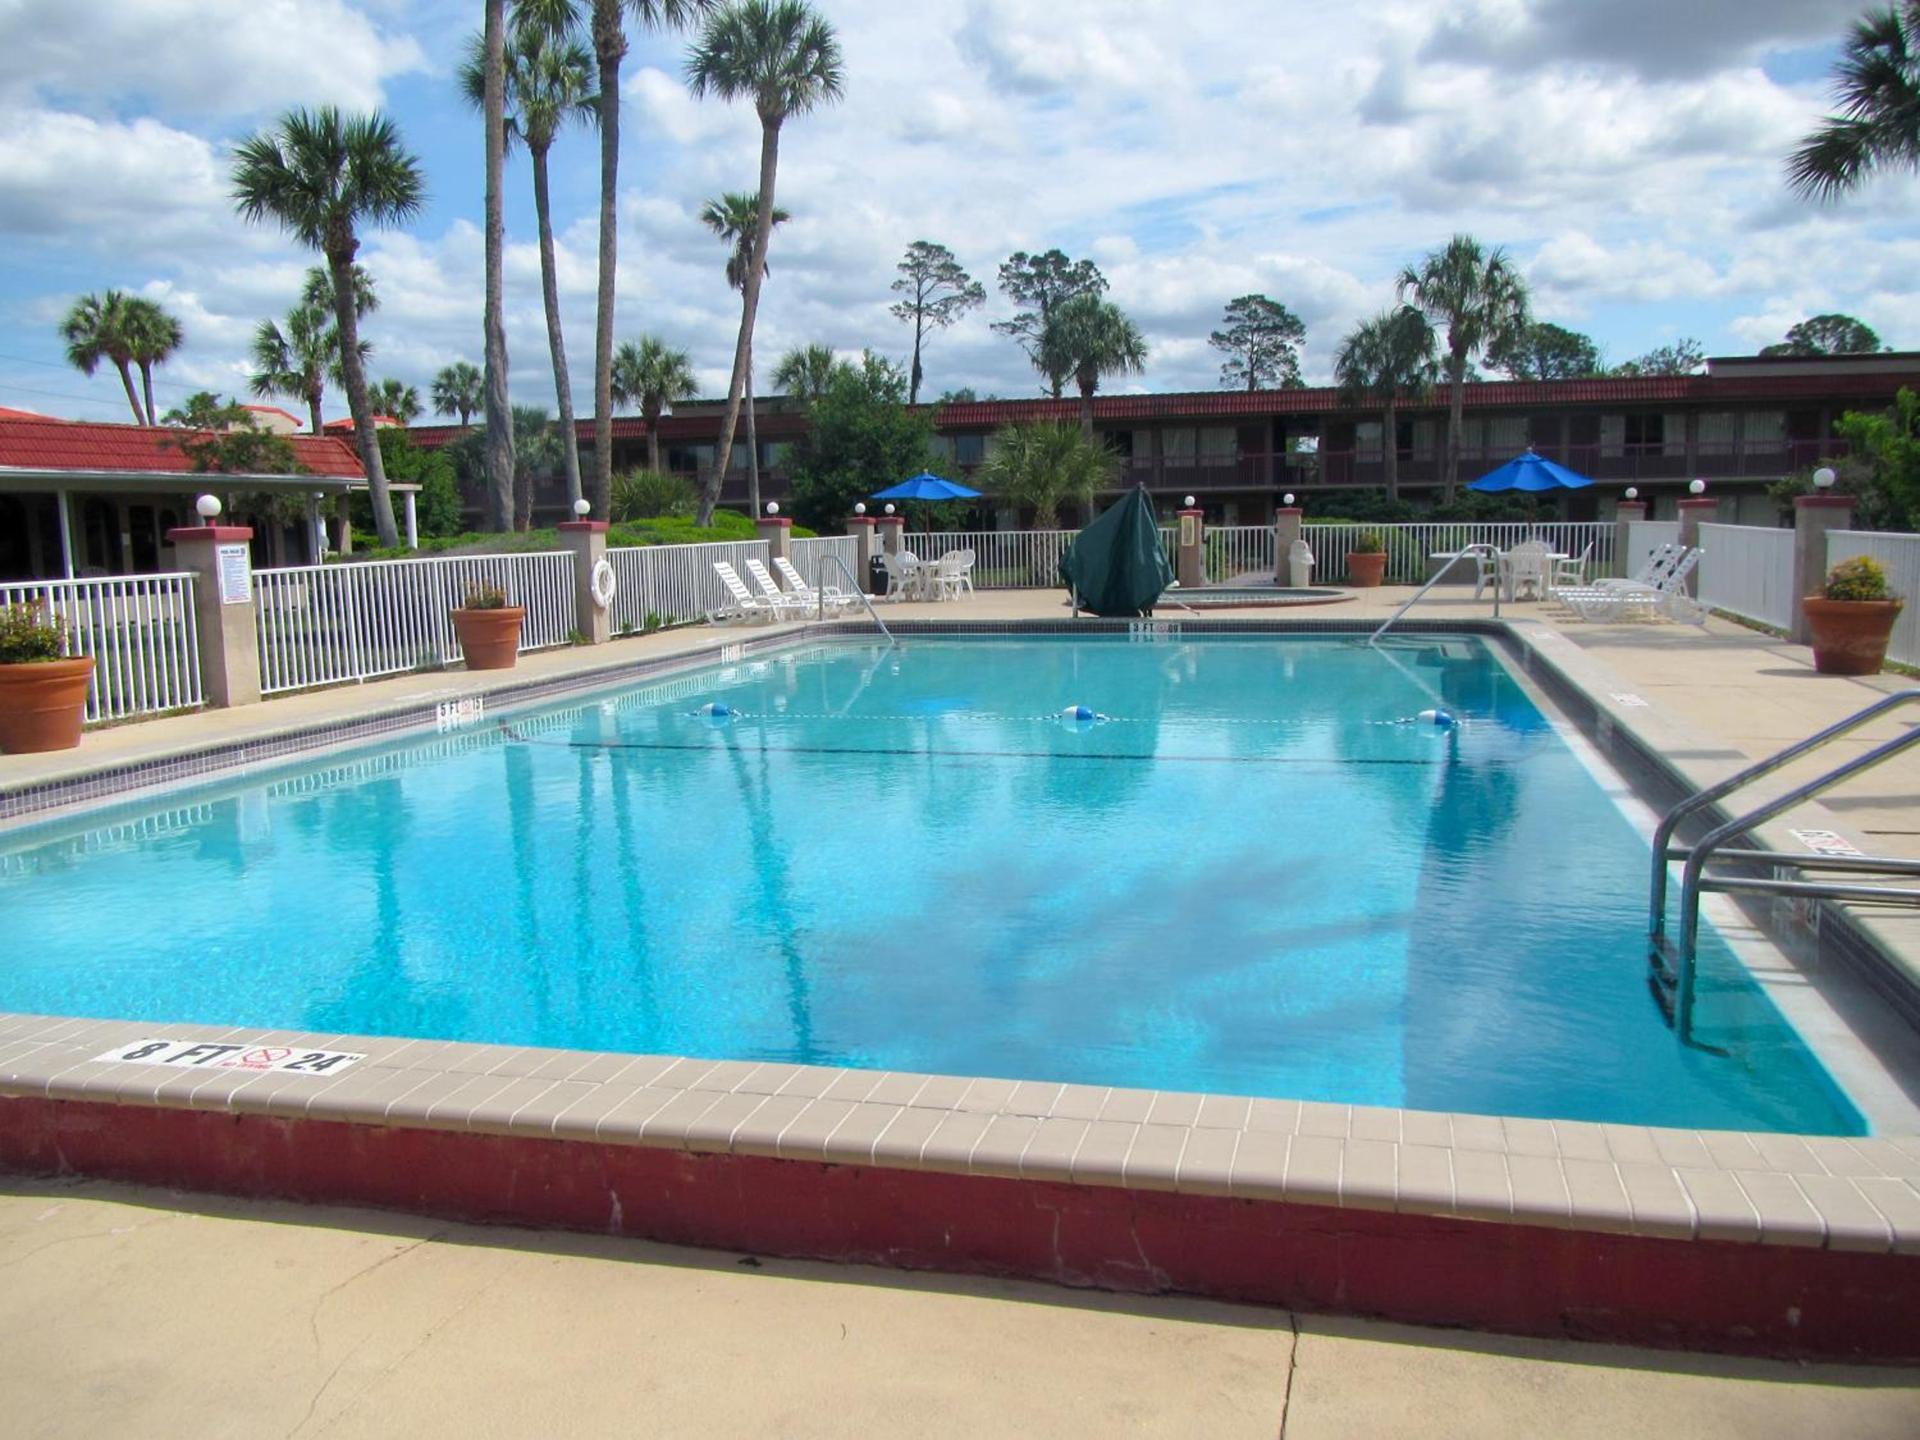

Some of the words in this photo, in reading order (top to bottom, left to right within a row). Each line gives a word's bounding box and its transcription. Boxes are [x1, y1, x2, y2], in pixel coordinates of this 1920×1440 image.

[1143, 622, 1154, 632] FT
[440, 702, 447, 717] 5
[450, 700, 460, 715] FT
[122, 1042, 171, 1061] 8
[165, 1044, 242, 1064] FT
